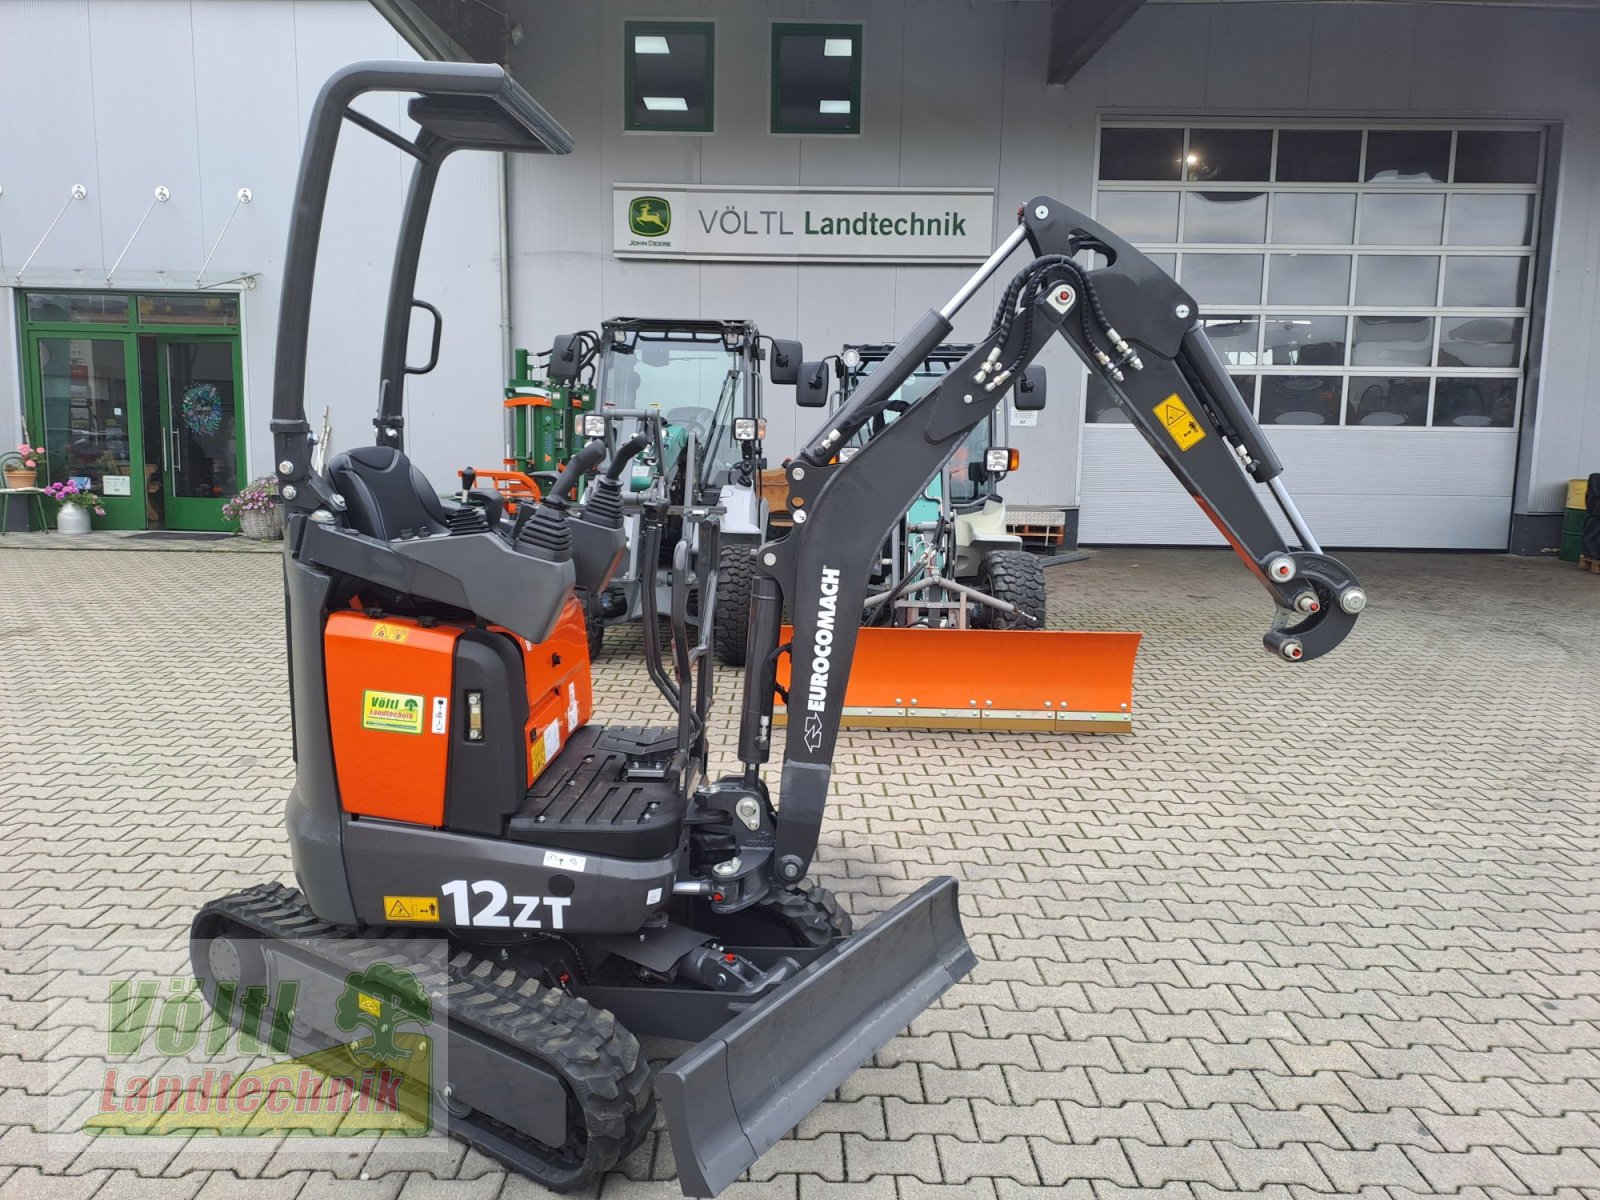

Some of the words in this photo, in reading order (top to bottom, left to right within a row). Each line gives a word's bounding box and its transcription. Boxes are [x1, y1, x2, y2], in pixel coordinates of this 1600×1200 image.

[698, 205, 794, 236] VÖLTL
[804, 211, 967, 236] Landtechnik
[807, 568, 841, 713] EUROCOMACH
[371, 696, 400, 710] Völtl
[369, 709, 414, 720] Landtechnik
